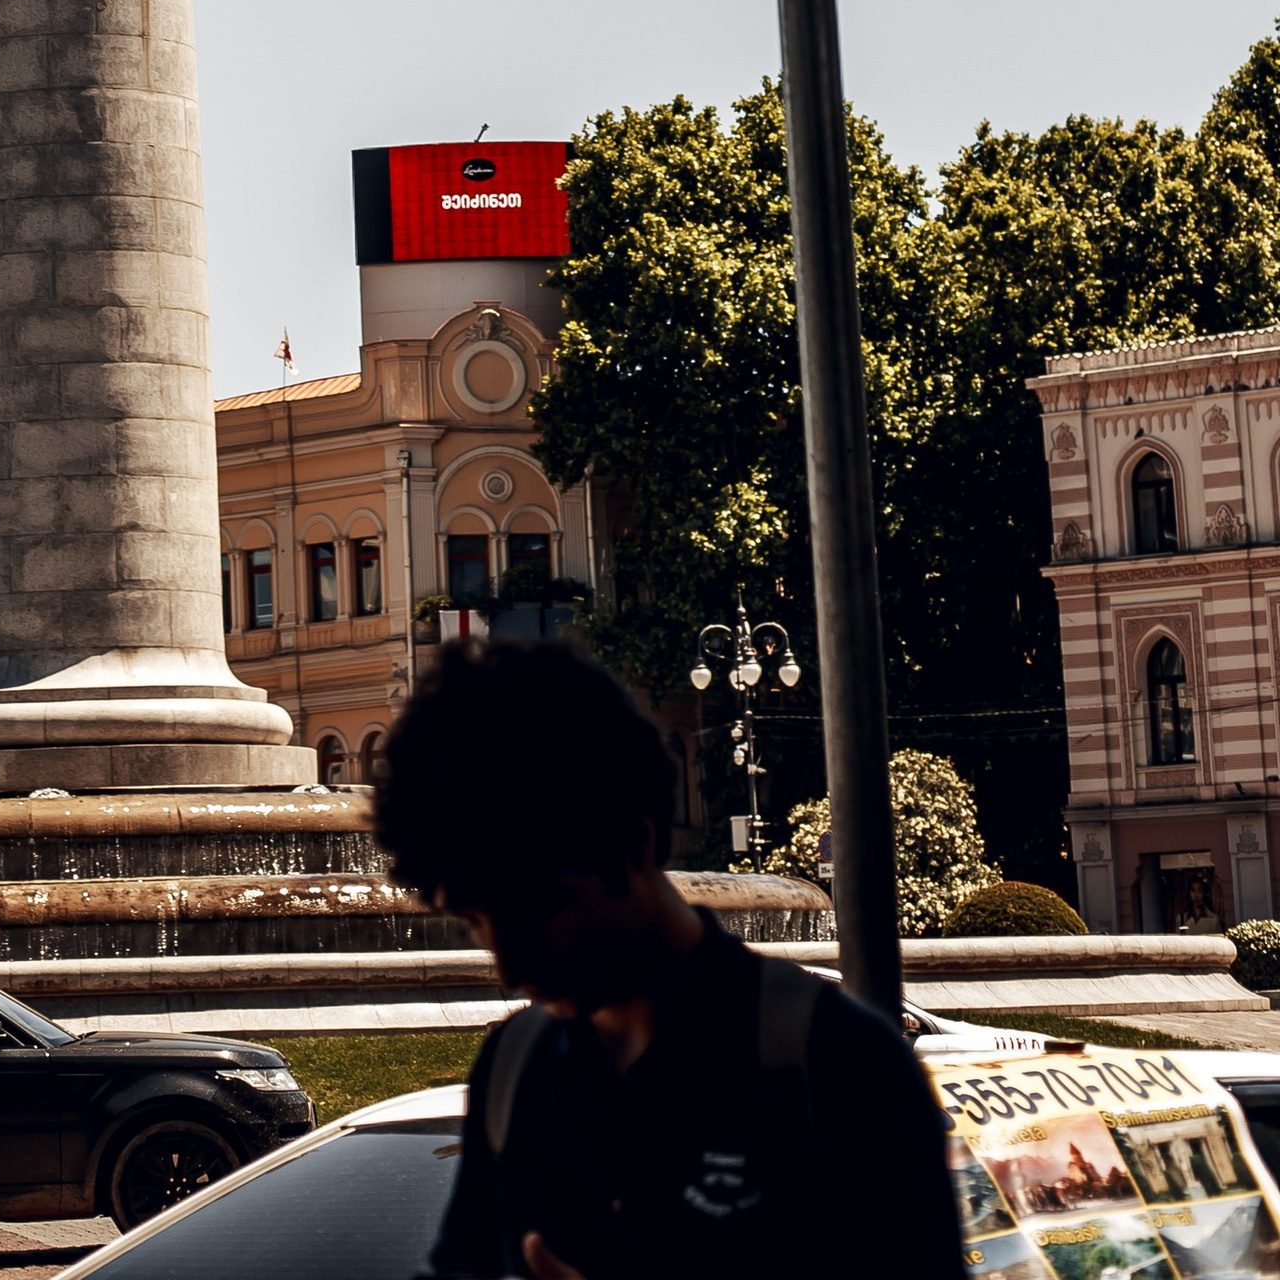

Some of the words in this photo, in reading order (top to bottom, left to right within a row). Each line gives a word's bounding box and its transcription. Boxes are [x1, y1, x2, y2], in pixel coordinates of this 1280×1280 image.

[441, 192, 522, 210] შეიძინეთ
[939, 1055, 1203, 1131] -555-70-70-01
[1148, 1103, 1212, 1124] museum
